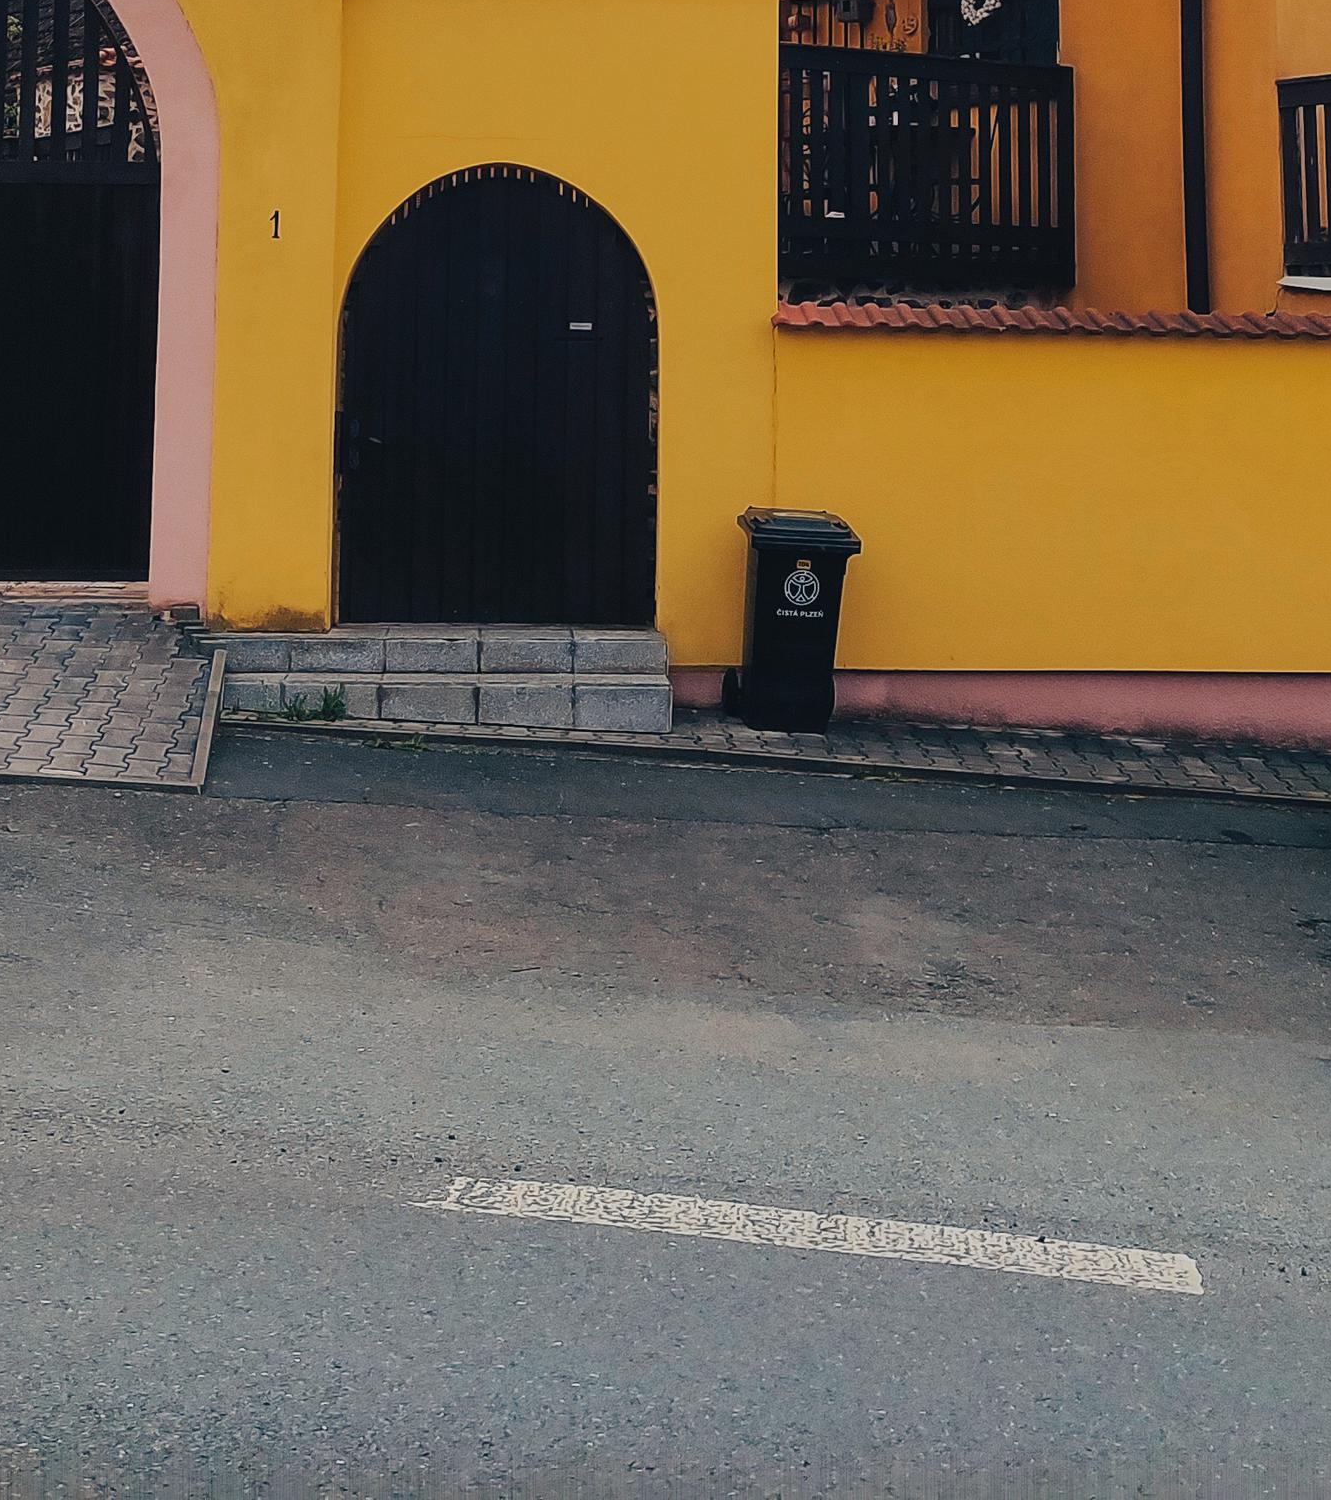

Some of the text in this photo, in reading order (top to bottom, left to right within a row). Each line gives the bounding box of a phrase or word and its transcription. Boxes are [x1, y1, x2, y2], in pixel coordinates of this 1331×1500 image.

[269, 209, 281, 239] 1
[776, 608, 824, 618] ČISTÁ PLZEŇ
